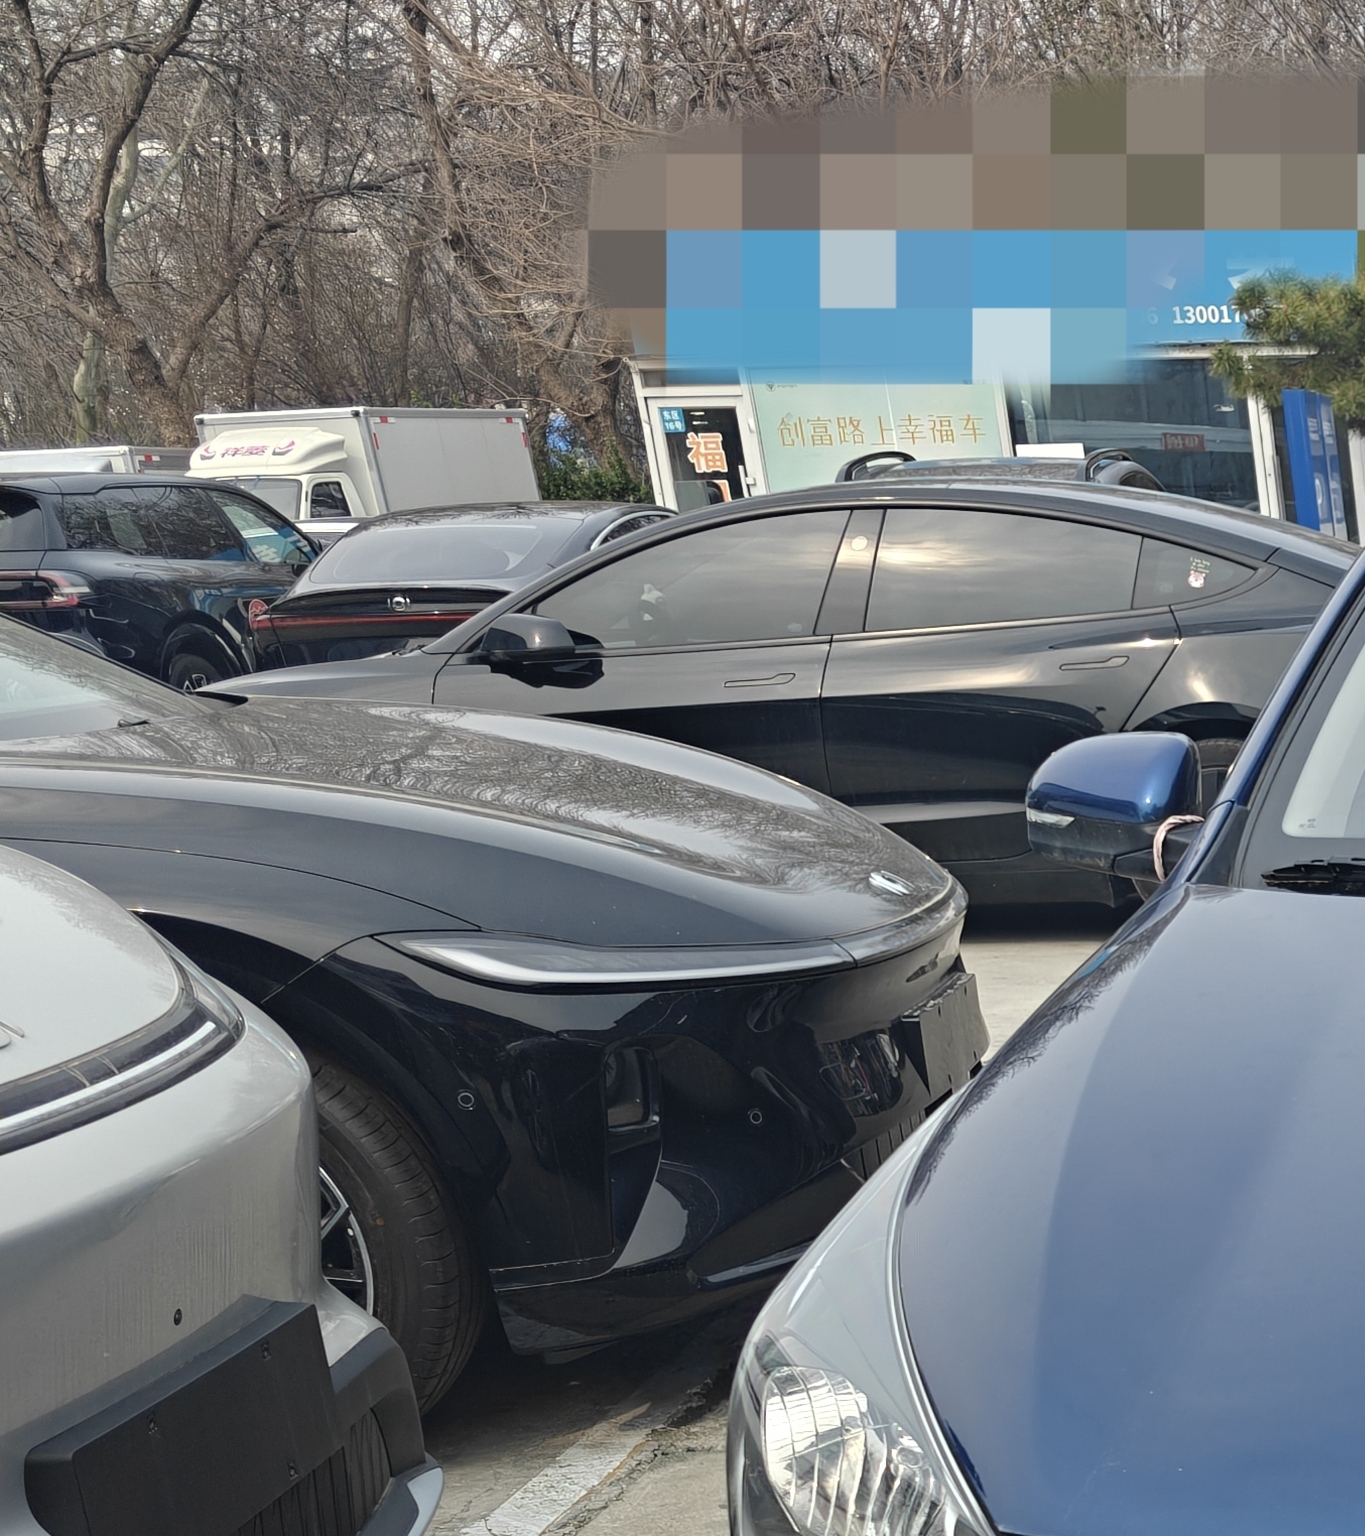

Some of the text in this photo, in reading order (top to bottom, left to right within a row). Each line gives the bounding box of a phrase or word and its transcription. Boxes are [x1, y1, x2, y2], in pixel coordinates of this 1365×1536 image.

[777, 414, 986, 448] 创富路上幸福车
[686, 432, 728, 473] 福
